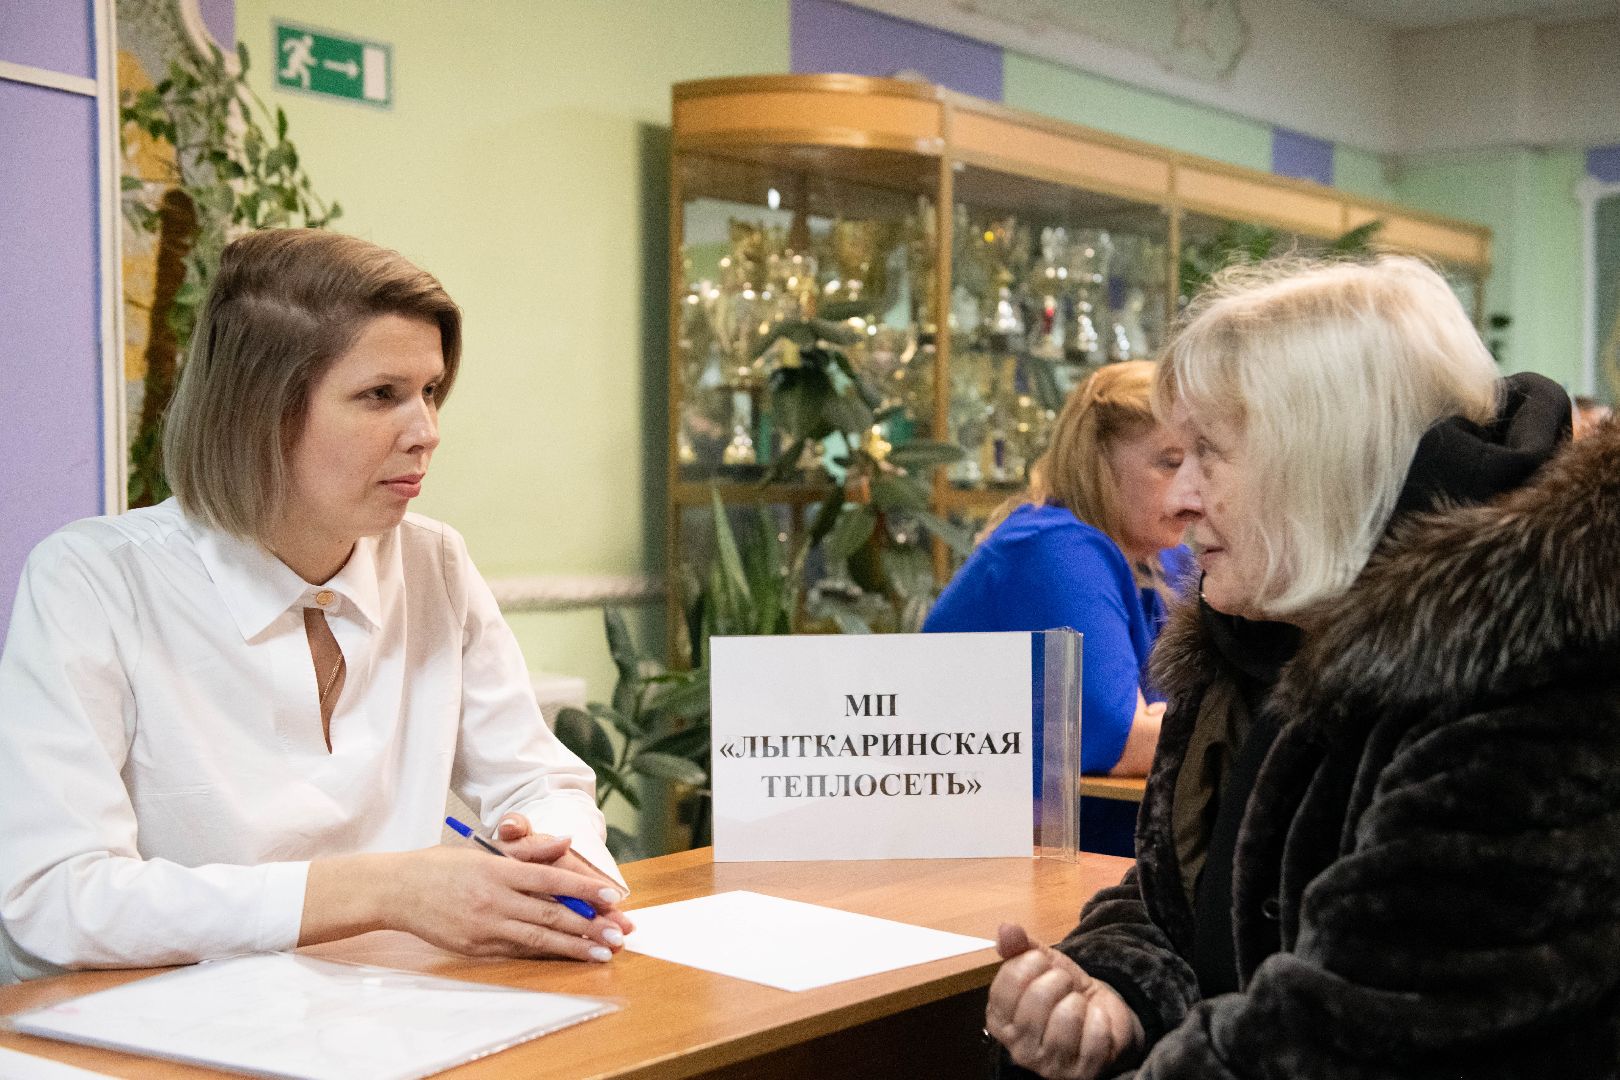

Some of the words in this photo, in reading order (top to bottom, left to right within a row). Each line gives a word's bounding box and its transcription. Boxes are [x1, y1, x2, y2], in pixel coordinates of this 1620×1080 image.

[845, 693, 898, 716] МП
[719, 731, 1022, 758] «ЛЫТКАРИНСКАЯ
[761, 772, 982, 798] ТЕПЛОСЕТЬ»
